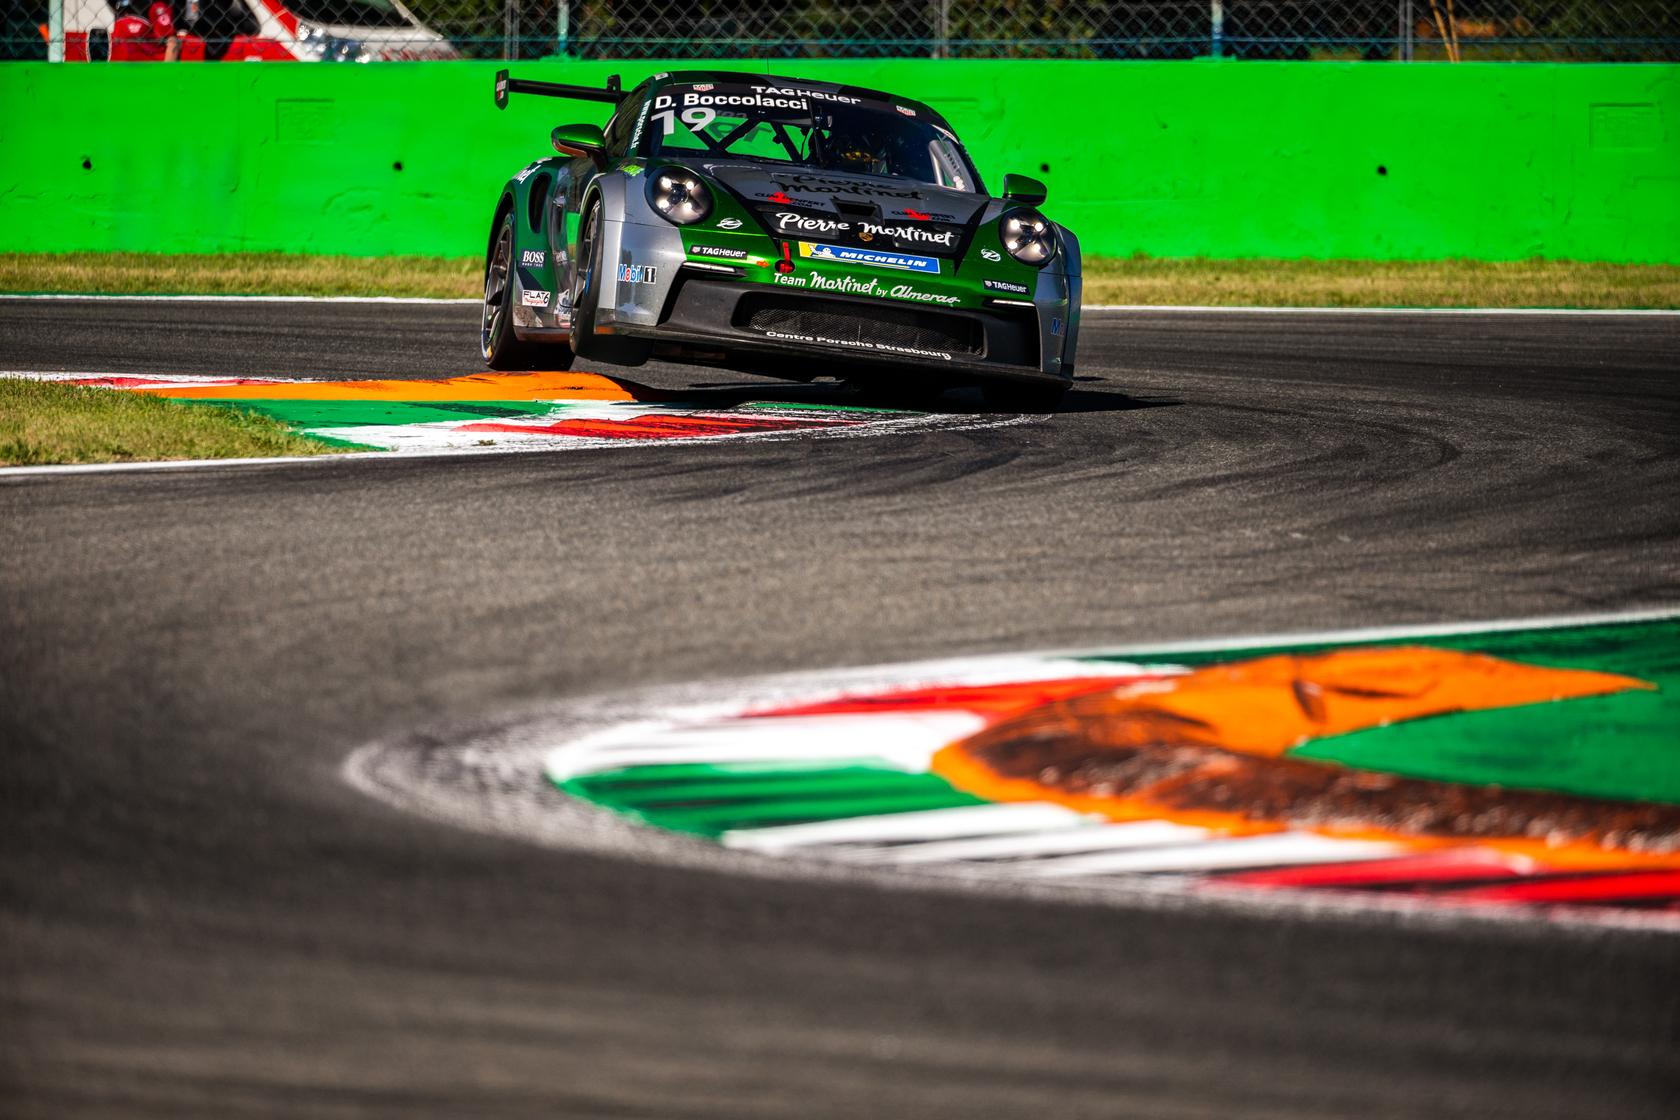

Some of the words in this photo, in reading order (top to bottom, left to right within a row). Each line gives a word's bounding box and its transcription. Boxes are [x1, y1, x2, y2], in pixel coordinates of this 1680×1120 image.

[654, 95, 677, 109] D.
[684, 93, 808, 111] Boccolacci
[651, 107, 716, 135] 19
[775, 212, 850, 232] Pierre
[522, 250, 545, 263] BOSS
[839, 251, 928, 268] MICHELIN
[618, 263, 644, 283] Mobil
[773, 272, 806, 287] Team
[876, 288, 888, 298] by
[766, 331, 813, 342] Centre
[816, 336, 874, 348] Porsche
[875, 343, 952, 361] Strasbourg
